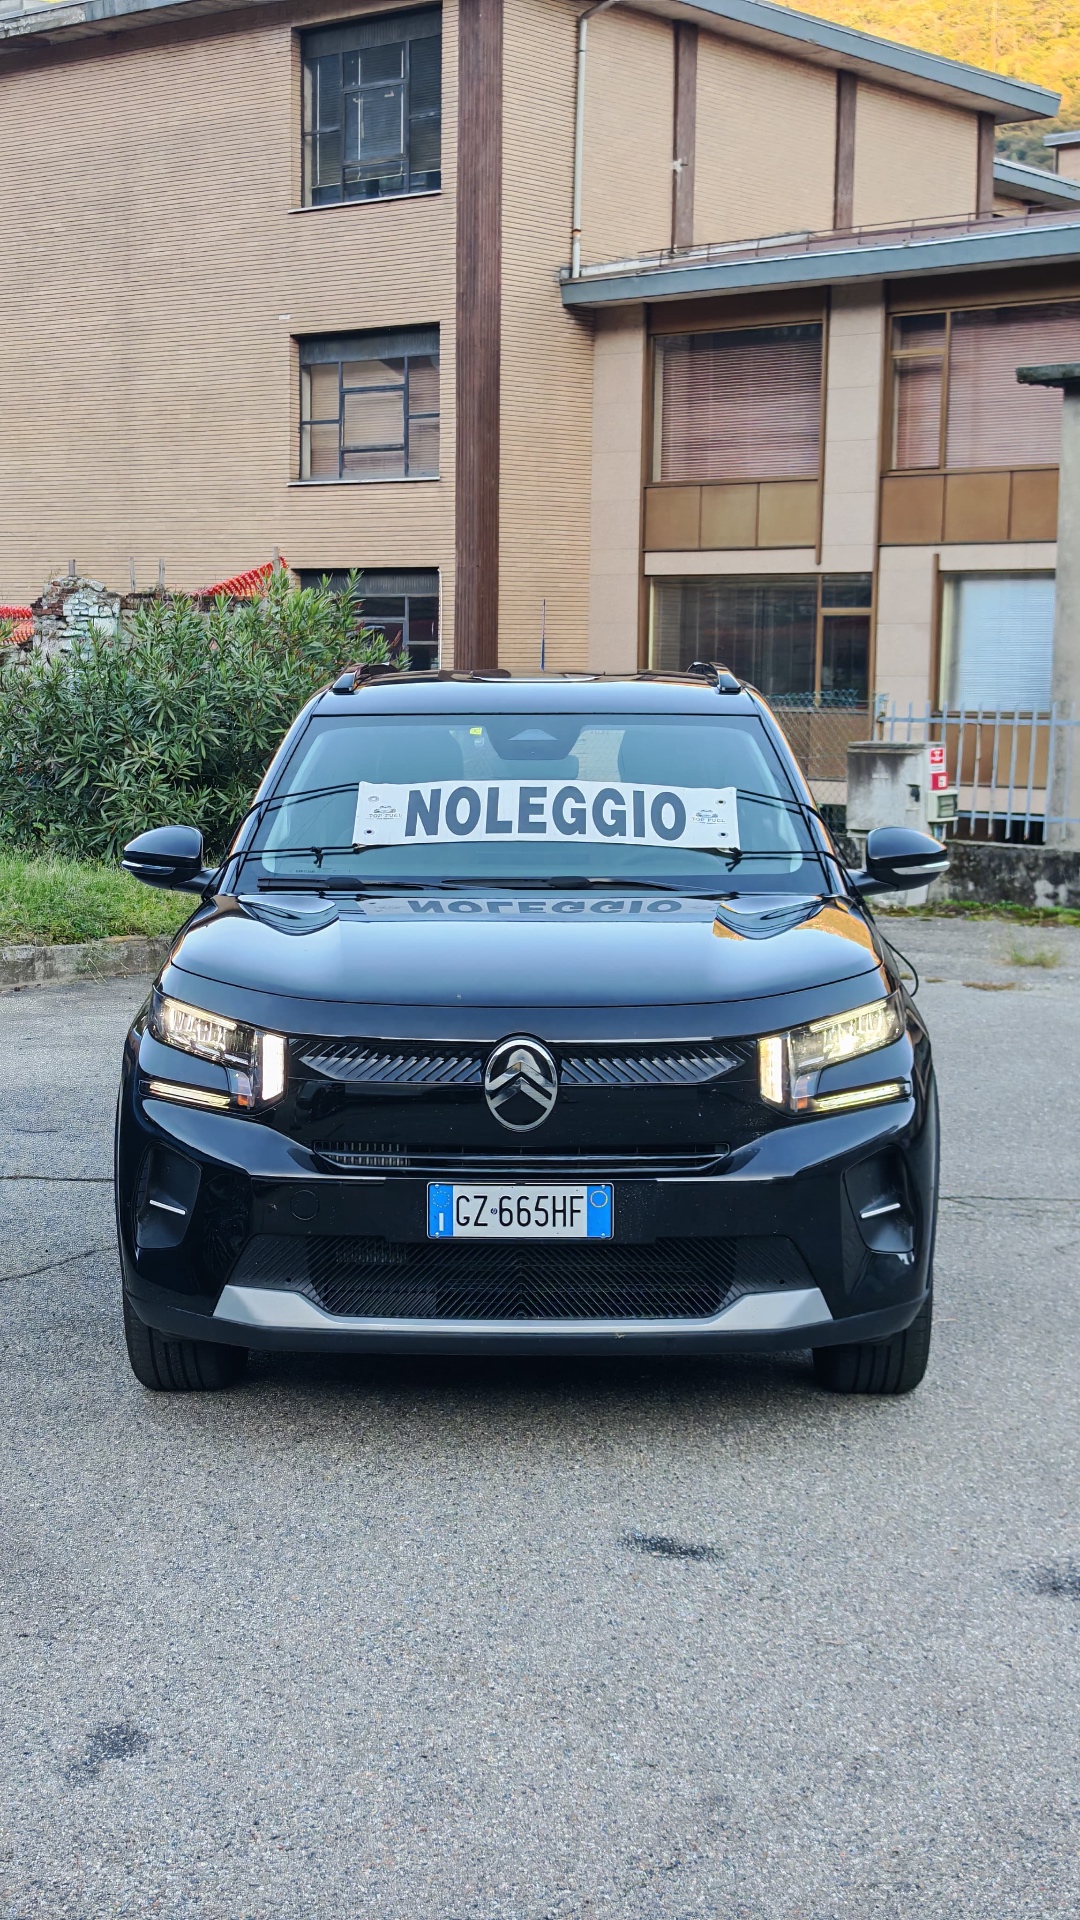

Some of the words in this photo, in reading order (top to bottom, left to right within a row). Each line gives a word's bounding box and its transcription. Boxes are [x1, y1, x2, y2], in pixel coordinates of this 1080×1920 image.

[405, 786, 686, 841] NOLEGGIO
[456, 1195, 488, 1227] GZ
[498, 1195, 584, 1227] 665HF
